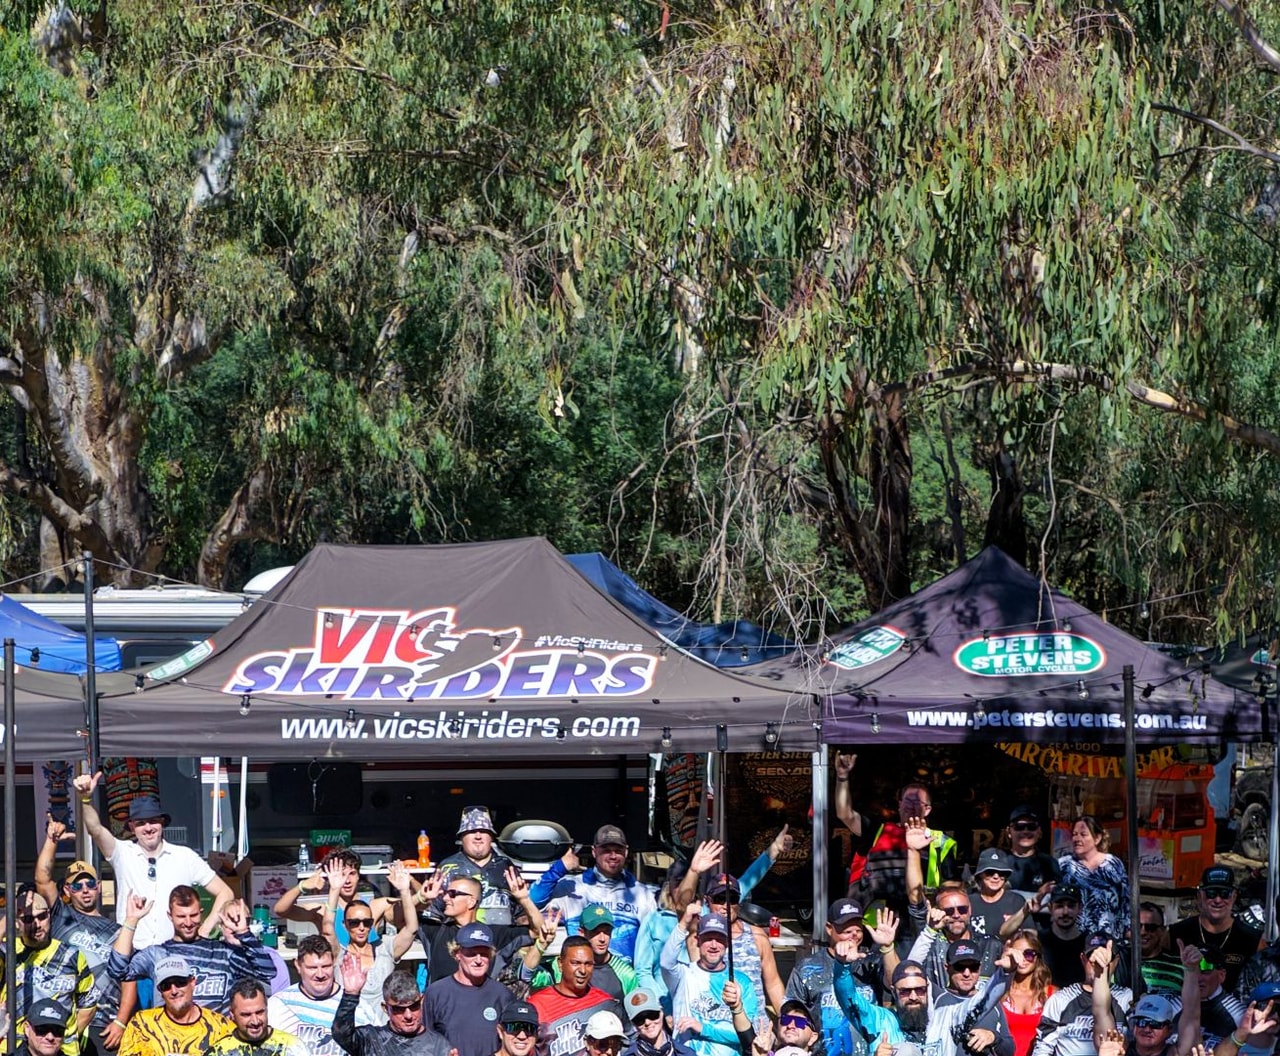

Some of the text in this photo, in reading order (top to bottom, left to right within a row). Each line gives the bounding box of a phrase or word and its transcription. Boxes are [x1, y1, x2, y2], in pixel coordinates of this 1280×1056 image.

[319, 608, 456, 664] VIC
[988, 635, 1073, 654] PETER
[971, 649, 1093, 670] STEVENS
[994, 663, 1077, 675] MOTOR CYCLES
[280, 709, 641, 740] www.vicskiriders.com
